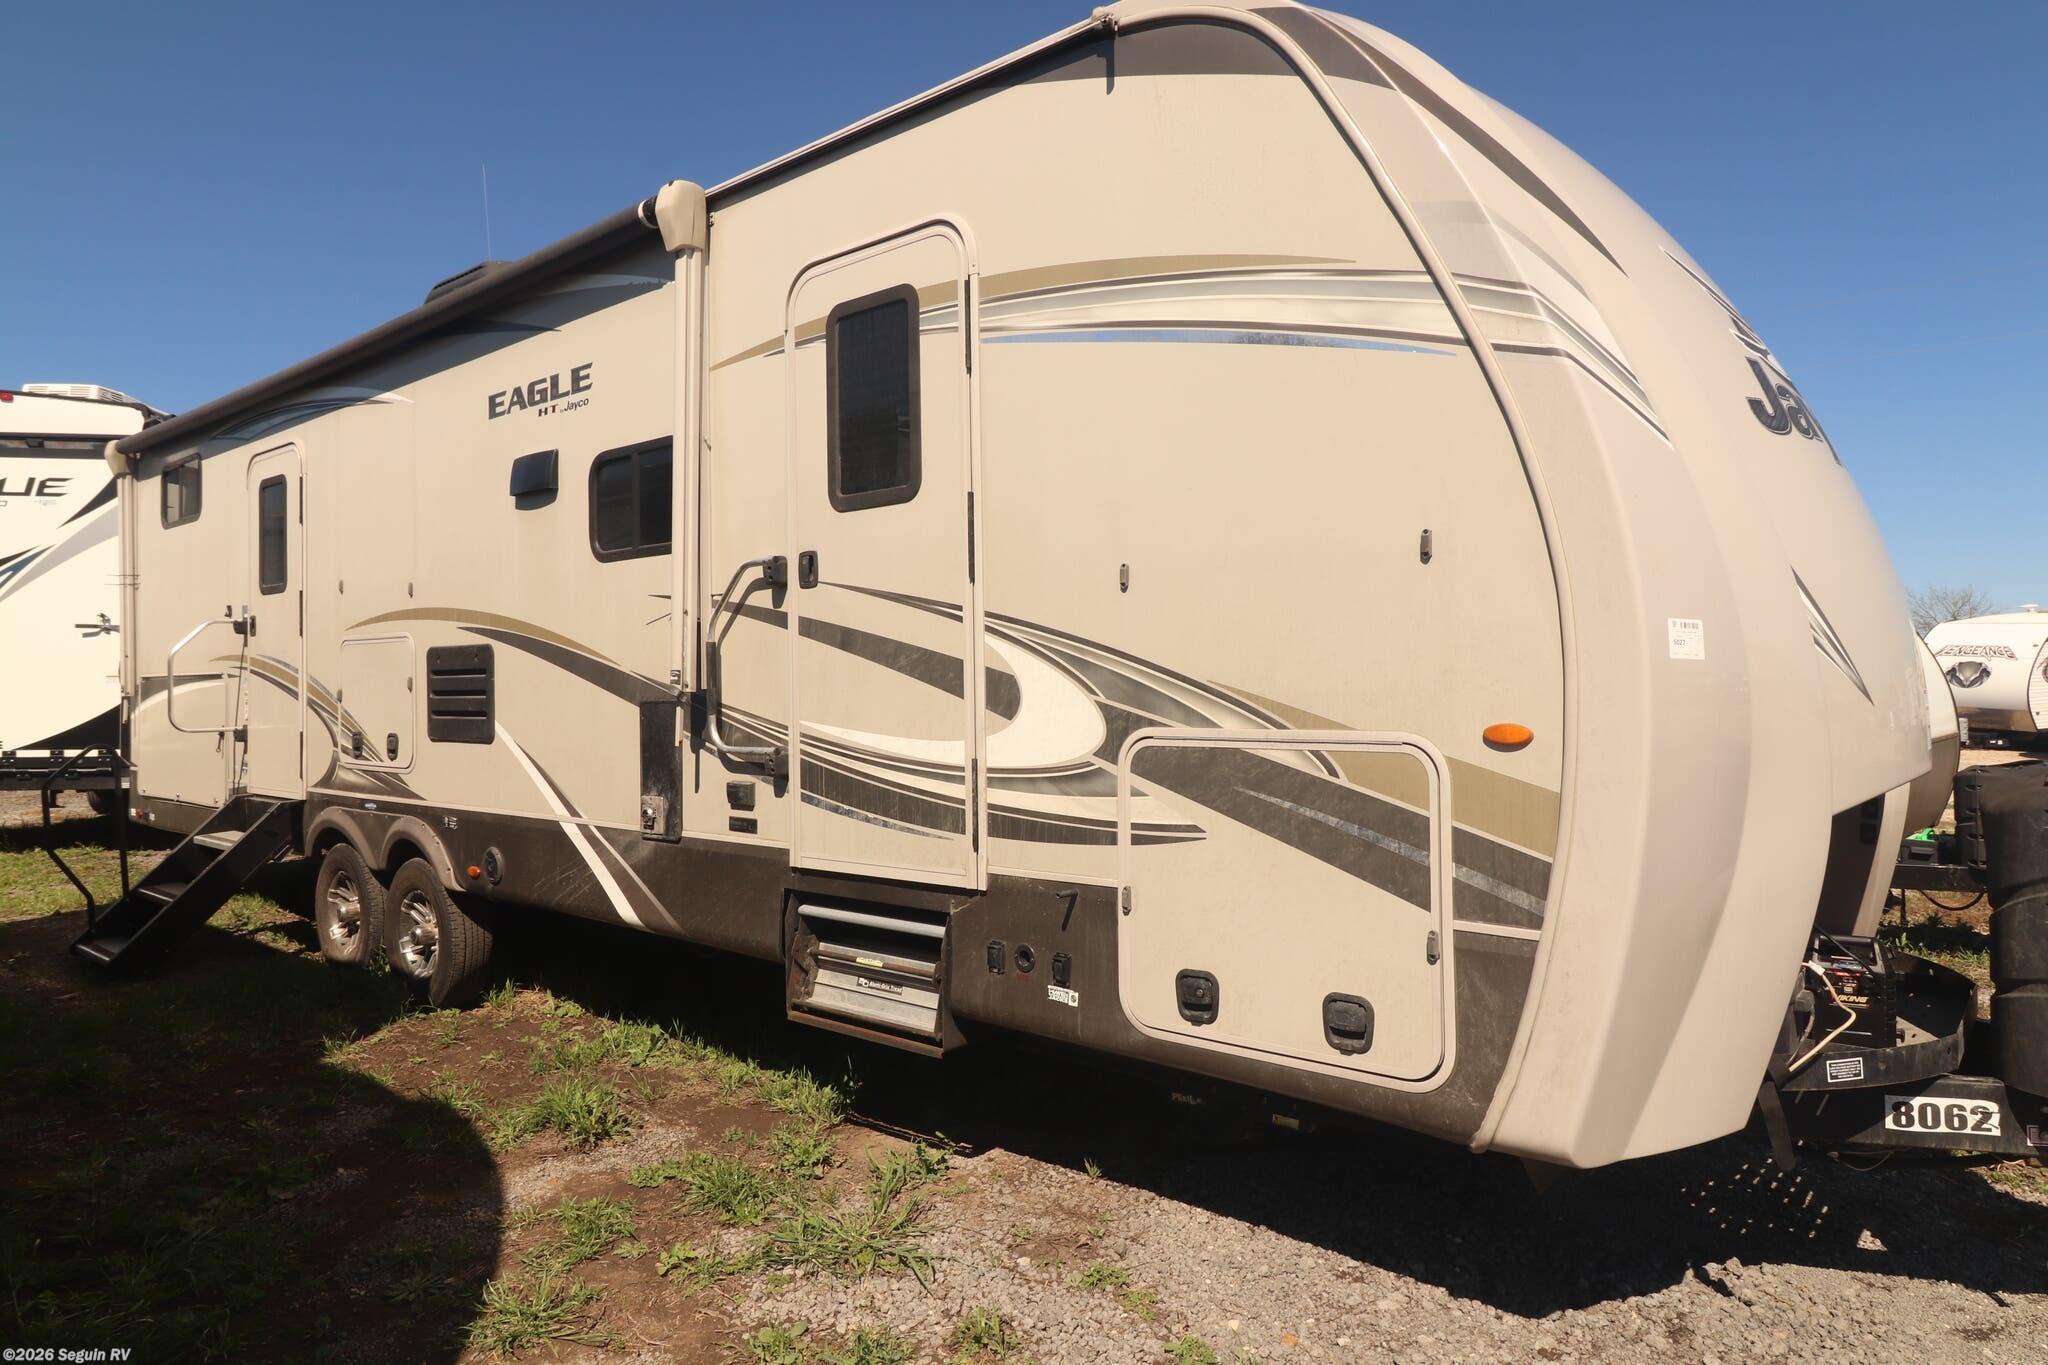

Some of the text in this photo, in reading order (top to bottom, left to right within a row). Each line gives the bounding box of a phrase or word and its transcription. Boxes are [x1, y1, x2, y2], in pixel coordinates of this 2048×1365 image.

[488, 362, 593, 420] EAGLE
[538, 398, 589, 417] HT Jayco
[1745, 356, 1841, 467] Ja
[1891, 1101, 1993, 1132] 8062
